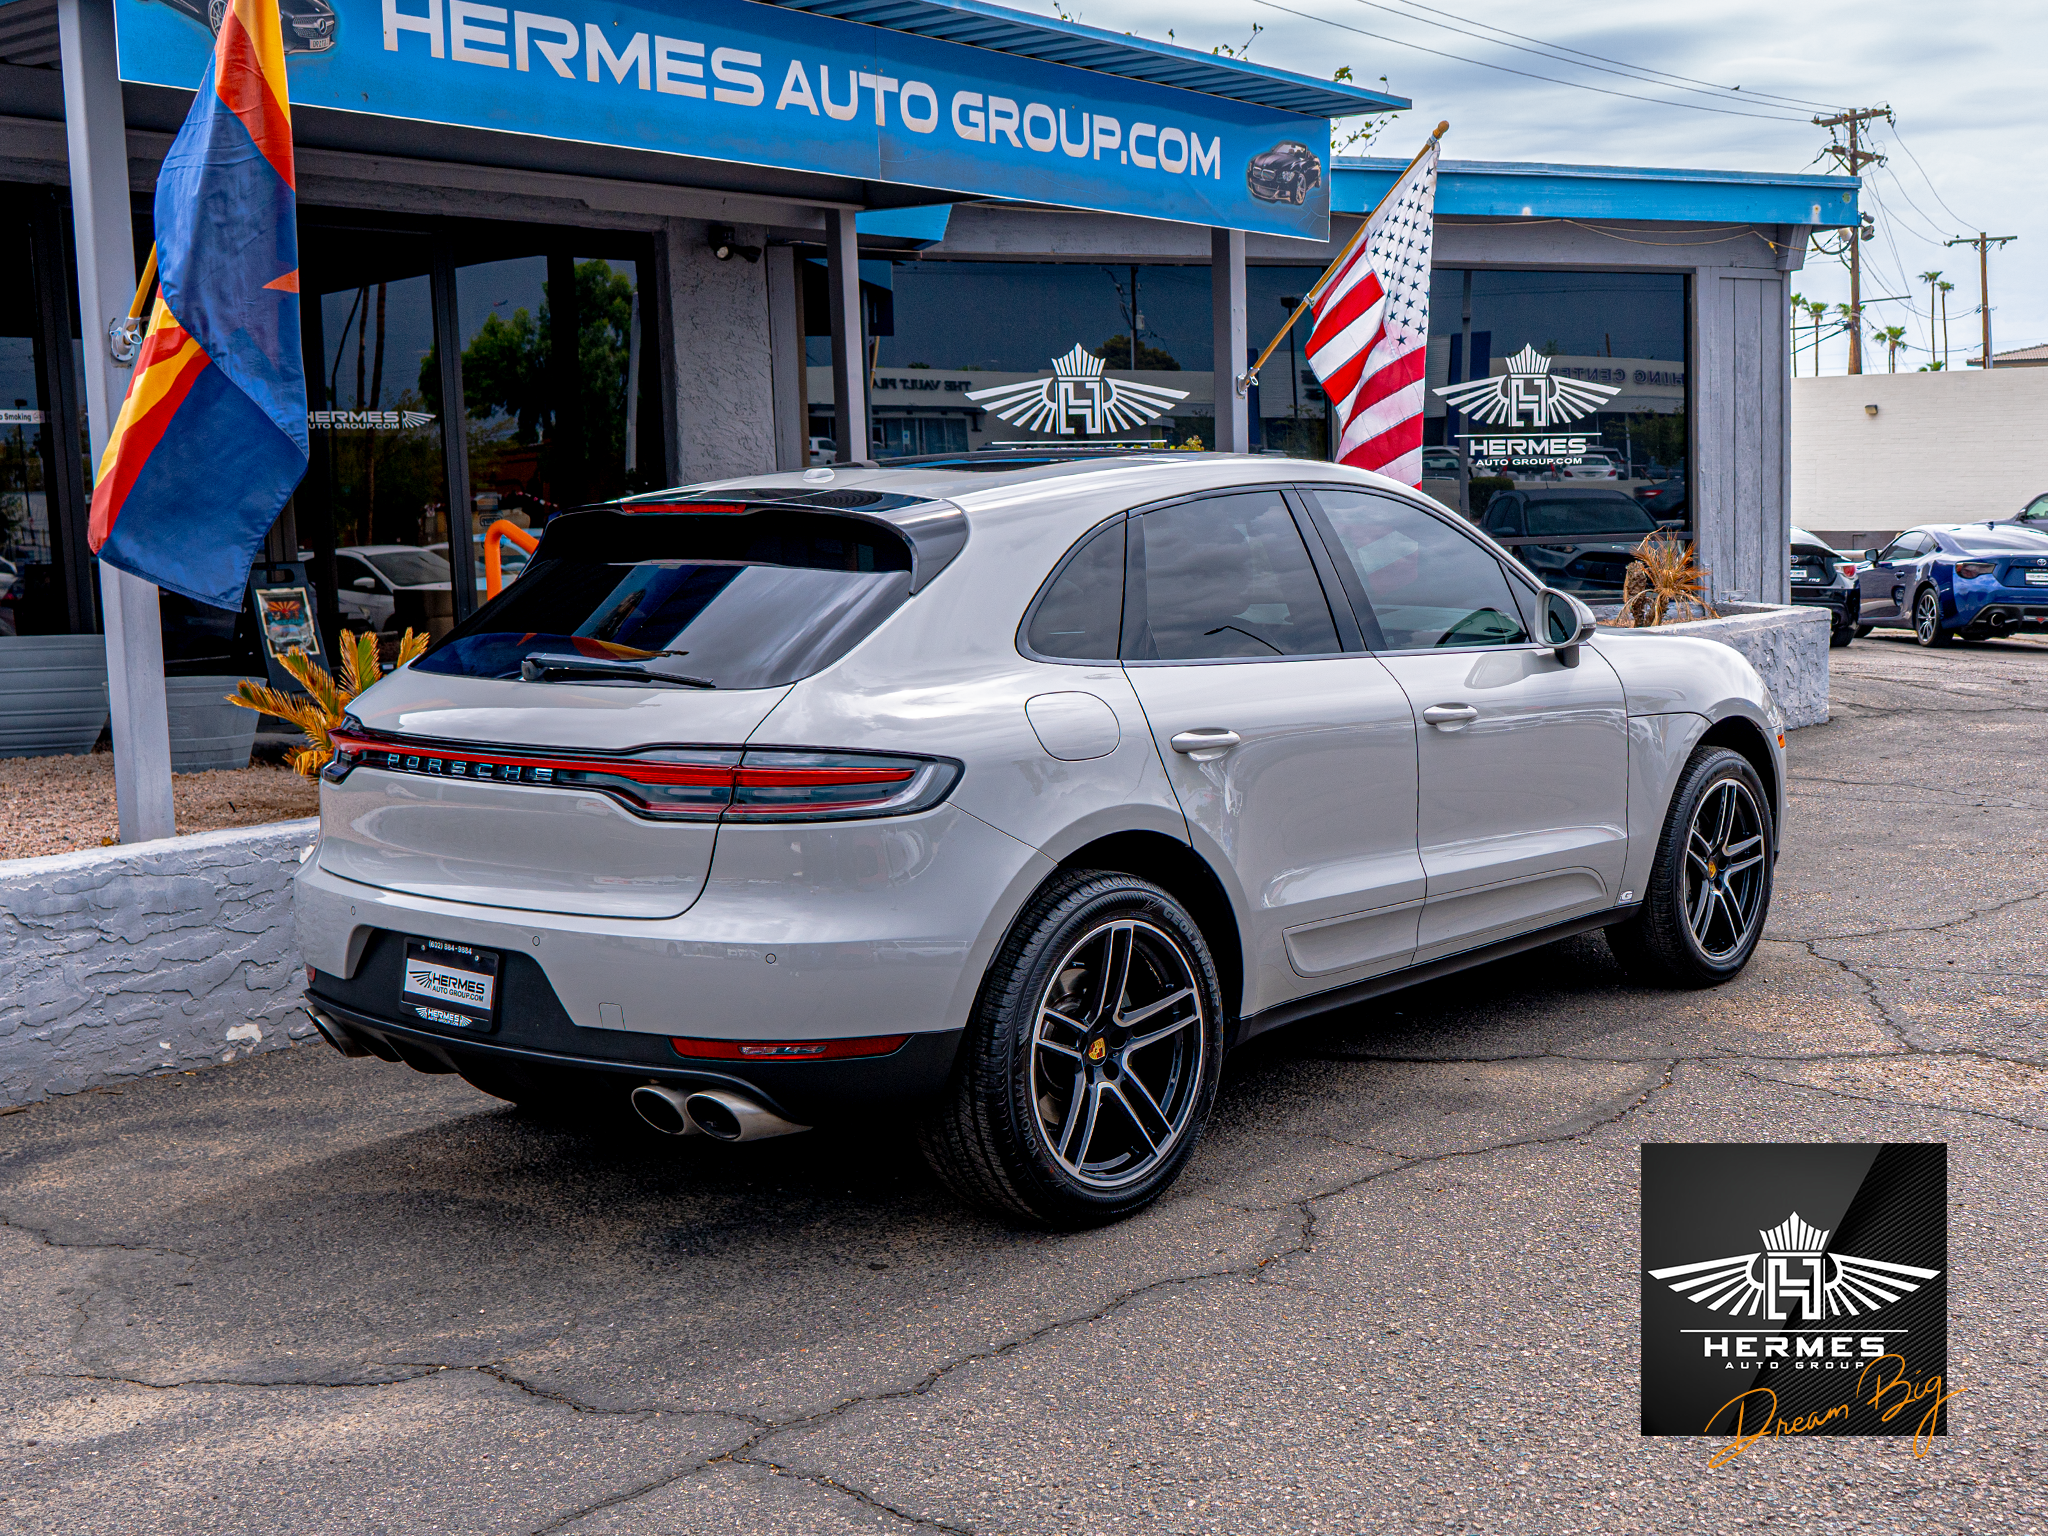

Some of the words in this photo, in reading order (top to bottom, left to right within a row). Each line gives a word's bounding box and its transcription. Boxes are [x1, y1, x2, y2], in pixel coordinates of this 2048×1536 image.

[382, 0, 764, 107] HERMES
[776, 59, 938, 134] AUTO
[951, 91, 1221, 180] GROUP.COM
[4, 412, 32, 422] Smoking
[309, 422, 331, 430] UTO
[334, 422, 400, 430] GROUP.COM
[1469, 438, 1587, 456] HERMES
[1476, 458, 1508, 466] AUTO
[1512, 457, 1583, 466] GROUP.COM
[387, 753, 553, 782] PORSCHE
[1162, 905, 1219, 1008] GEOLANDAR
[432, 973, 485, 994] HERMES
[432, 985, 448, 994] AUTO
[449, 989, 484, 1002] GROUP.COM
[428, 1008, 459, 1023] HERMES
